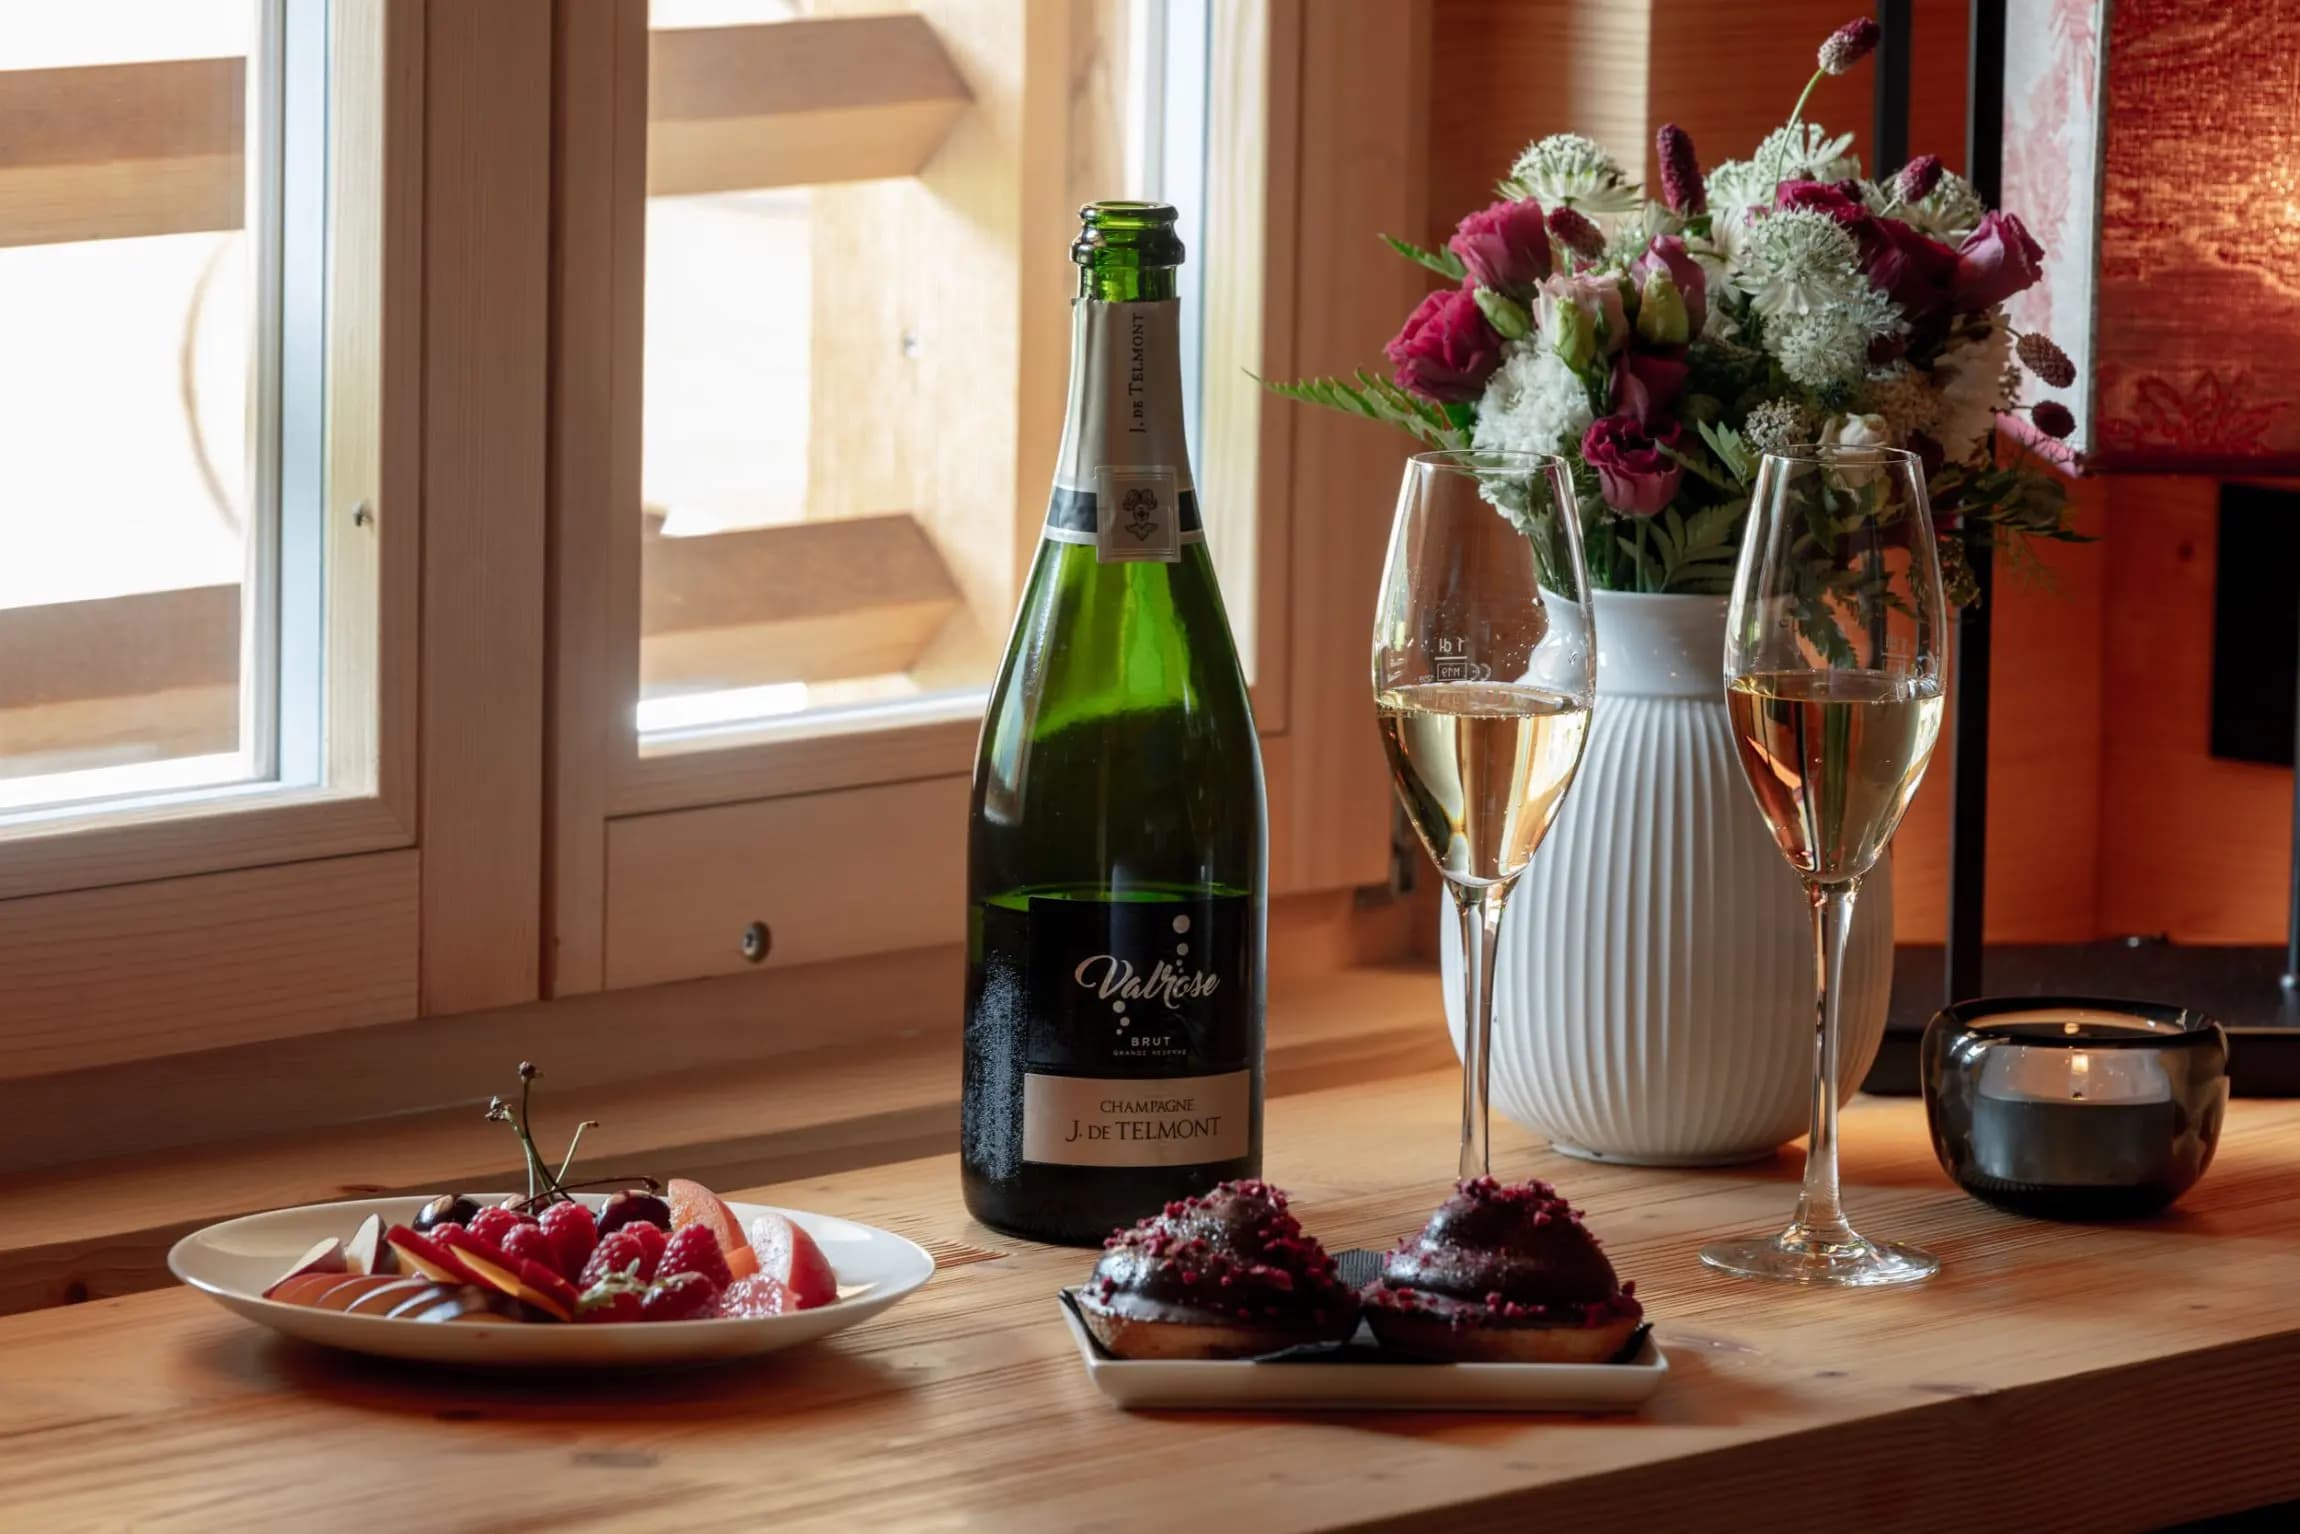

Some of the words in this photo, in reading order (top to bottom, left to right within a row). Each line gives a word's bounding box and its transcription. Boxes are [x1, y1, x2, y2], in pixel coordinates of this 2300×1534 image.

[1128, 312, 1145, 396] TELMONT
[1132, 401, 1144, 419] DE
[1074, 954, 1221, 1010] Valrose
[1130, 1036, 1172, 1048] BRUT
[1099, 1098, 1196, 1114] CHAMPAGNE
[1065, 1119, 1084, 1142] J.
[1088, 1125, 1111, 1141] DE
[1115, 1116, 1222, 1141] TELMONT
